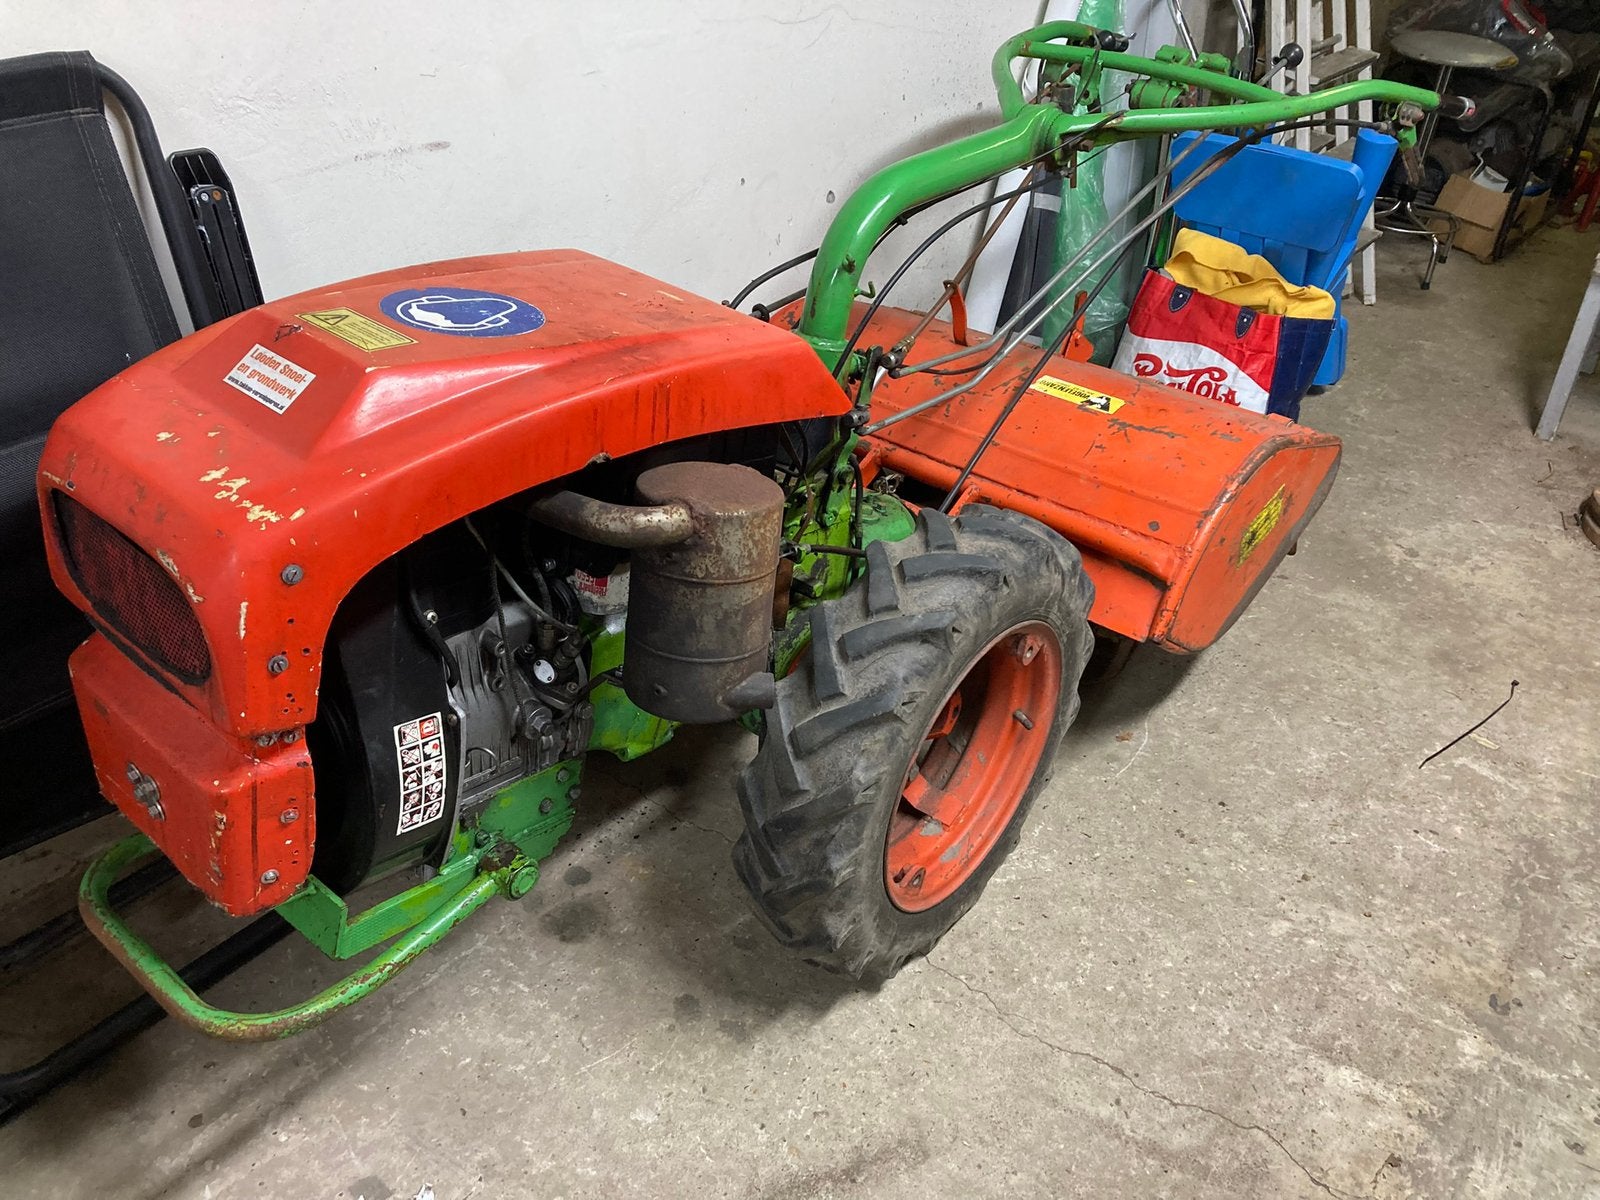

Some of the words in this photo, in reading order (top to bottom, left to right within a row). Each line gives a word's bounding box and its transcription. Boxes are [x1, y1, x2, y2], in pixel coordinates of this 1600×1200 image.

[237, 362, 251, 374] en
[246, 368, 297, 400] grondwerk
[250, 348, 281, 371] Looden
[279, 364, 307, 384] Snoei-
